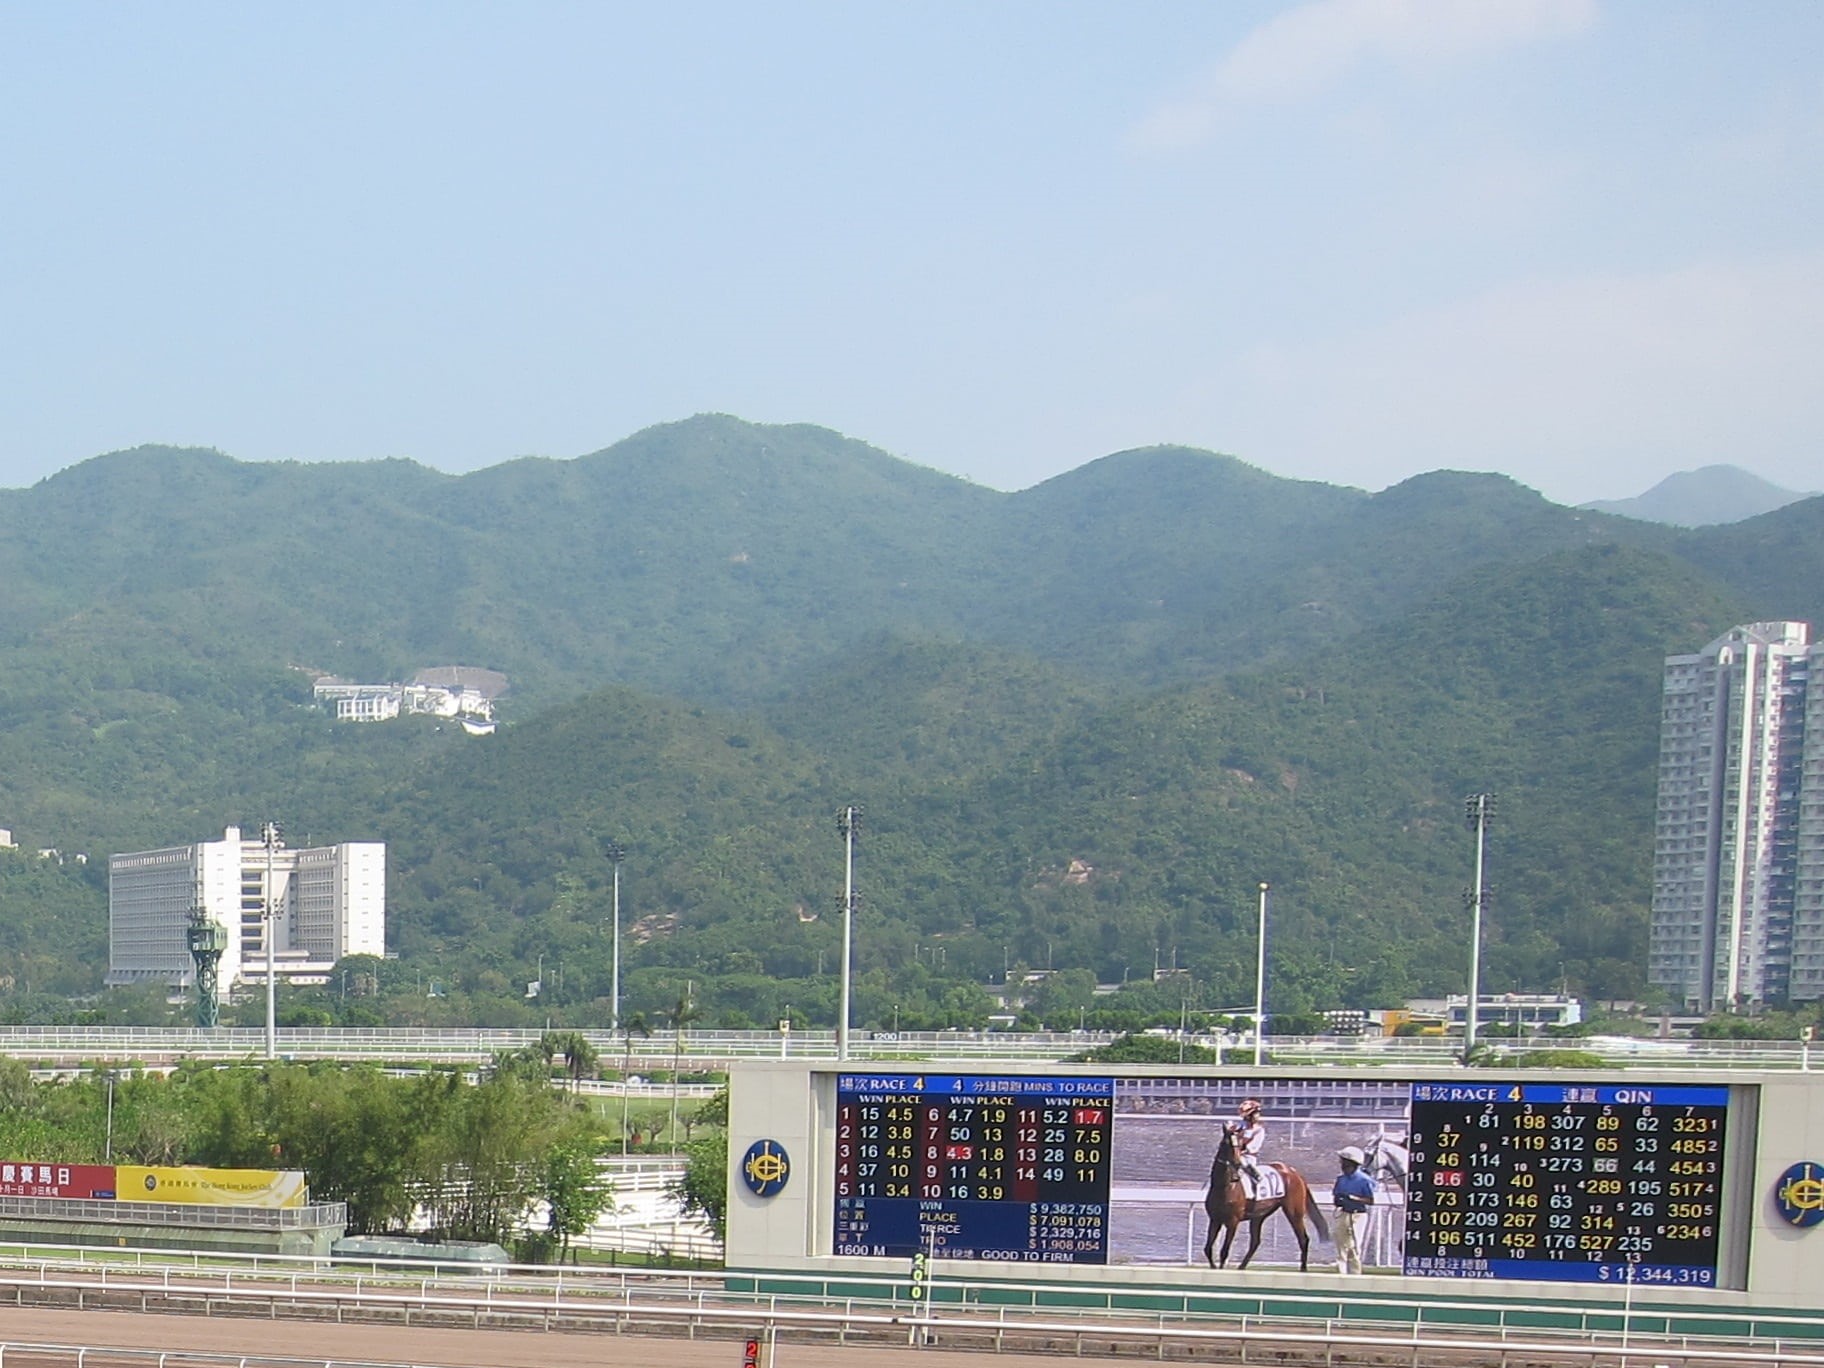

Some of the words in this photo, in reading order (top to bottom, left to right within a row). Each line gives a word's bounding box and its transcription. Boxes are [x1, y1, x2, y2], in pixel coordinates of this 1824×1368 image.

[871, 1079, 906, 1090] RACE
[913, 1077, 924, 1091] 4
[953, 1078, 963, 1091] 4
[1024, 1082, 1053, 1092] MINS
[1059, 1083, 1074, 1092] TO
[1077, 1083, 1109, 1092] RACE
[859, 1095, 884, 1103] WIN
[885, 1095, 922, 1104] PLACE
[950, 1096, 975, 1104] WIN
[977, 1096, 1014, 1105] PLACE
[1045, 1097, 1070, 1106] WIN
[1072, 1098, 1110, 1107] PLACE
[1451, 1088, 1497, 1101] RACE
[1508, 1086, 1521, 1101] 4
[1615, 1090, 1652, 1104] QIN
[842, 1107, 849, 1120] 1
[861, 1107, 879, 1120] 15
[887, 1108, 913, 1121] 4.5
[928, 1108, 939, 1121] 6
[947, 1109, 973, 1121] 4.7
[981, 1109, 1006, 1123] 1.9
[1018, 1110, 1036, 1123] 11
[1043, 1110, 1068, 1124] 5.2
[1077, 1111, 1102, 1124] 1.7
[1485, 1103, 1494, 1114] 2
[1524, 1104, 1532, 1115] 3
[1562, 1104, 1571, 1115] 4
[1602, 1105, 1612, 1116] 5
[1642, 1106, 1652, 1117] 6
[1685, 1106, 1695, 1117] 7
[1479, 1115, 1500, 1128] 81
[1513, 1115, 1546, 1129] 198
[1551, 1116, 1586, 1130] 307
[1596, 1117, 1619, 1131] 89
[1636, 1117, 1659, 1132] 62
[1673, 1118, 1708, 1132] 323
[840, 1125, 850, 1139] 2
[860, 1126, 878, 1139] 12
[887, 1126, 912, 1139] 3.8
[928, 1127, 938, 1140] 7
[950, 1127, 970, 1141] 50
[983, 1128, 1002, 1141] 13
[1017, 1128, 1037, 1142] 12
[1044, 1129, 1065, 1142] 25
[1076, 1129, 1101, 1143] 7.5
[1438, 1134, 1460, 1147] 37
[1512, 1136, 1545, 1150] 119
[1550, 1136, 1584, 1151] 312
[1595, 1137, 1618, 1152] 65
[1635, 1138, 1658, 1152] 33
[1671, 1140, 1706, 1154] 485
[840, 1144, 850, 1158] 3
[859, 1145, 878, 1158] 16
[886, 1146, 912, 1159] 4.5
[927, 1146, 937, 1159] 8
[946, 1146, 972, 1160] 4.3
[980, 1147, 1004, 1161] 1.8
[1017, 1148, 1036, 1161] 13
[1043, 1148, 1065, 1162] 28
[1074, 1149, 1100, 1163] 8.0
[1436, 1153, 1460, 1167] 46
[1469, 1154, 1501, 1168] 114
[1549, 1158, 1583, 1172] 273
[1594, 1159, 1618, 1172] 66
[1633, 1160, 1656, 1173] 44
[1669, 1162, 1705, 1175] 454
[838, 1163, 849, 1176] 4
[858, 1163, 877, 1177] 37
[890, 1164, 909, 1178] 10
[927, 1165, 937, 1178] 9
[950, 1166, 966, 1179] 11
[977, 1166, 1002, 1180] 4.1
[1016, 1167, 1036, 1180] 14
[1042, 1168, 1064, 1181] 49
[1077, 1169, 1095, 1182] 11
[839, 1182, 849, 1195] 5
[858, 1183, 875, 1196] 11
[886, 1183, 910, 1197] 3.4
[922, 1184, 941, 1198] 10
[949, 1185, 968, 1199] 16
[978, 1186, 1003, 1200] 3.9
[1433, 1172, 1461, 1186] 8.6
[1473, 1173, 1495, 1187] 30
[1510, 1174, 1534, 1188] 40
[1586, 1180, 1622, 1194] 289
[1628, 1181, 1662, 1195] 195
[1669, 1183, 1704, 1196] 517
[919, 1201, 943, 1211] WIN
[1029, 1203, 1038, 1214] $
[1435, 1192, 1457, 1206] 73
[1467, 1193, 1499, 1207] 173
[1506, 1194, 1538, 1208] 146
[1550, 1195, 1573, 1209] 63
[1631, 1202, 1654, 1216] 26
[1668, 1204, 1702, 1218] 350
[919, 1212, 957, 1223] PLACE
[1029, 1215, 1037, 1226] $
[1430, 1212, 1461, 1226] 107
[1465, 1213, 1498, 1227] 209
[1503, 1214, 1537, 1227] 267
[1549, 1215, 1571, 1229] 92
[1581, 1216, 1614, 1230] 314
[1666, 1225, 1701, 1239] 234
[1029, 1226, 1037, 1238] $
[1029, 1239, 1036, 1249] $
[1428, 1231, 1461, 1245] 196
[1464, 1232, 1495, 1246] 511
[1501, 1234, 1536, 1247] 452
[1543, 1235, 1576, 1249] 176
[1579, 1236, 1614, 1249] 527
[1618, 1237, 1653, 1251] 235
[838, 1244, 868, 1255] 1600
[873, 1246, 885, 1256] M
[981, 1250, 1019, 1260] GOOD
[1023, 1251, 1039, 1261] TO
[1042, 1252, 1074, 1262] FIRM
[1599, 1267, 1609, 1279] $
